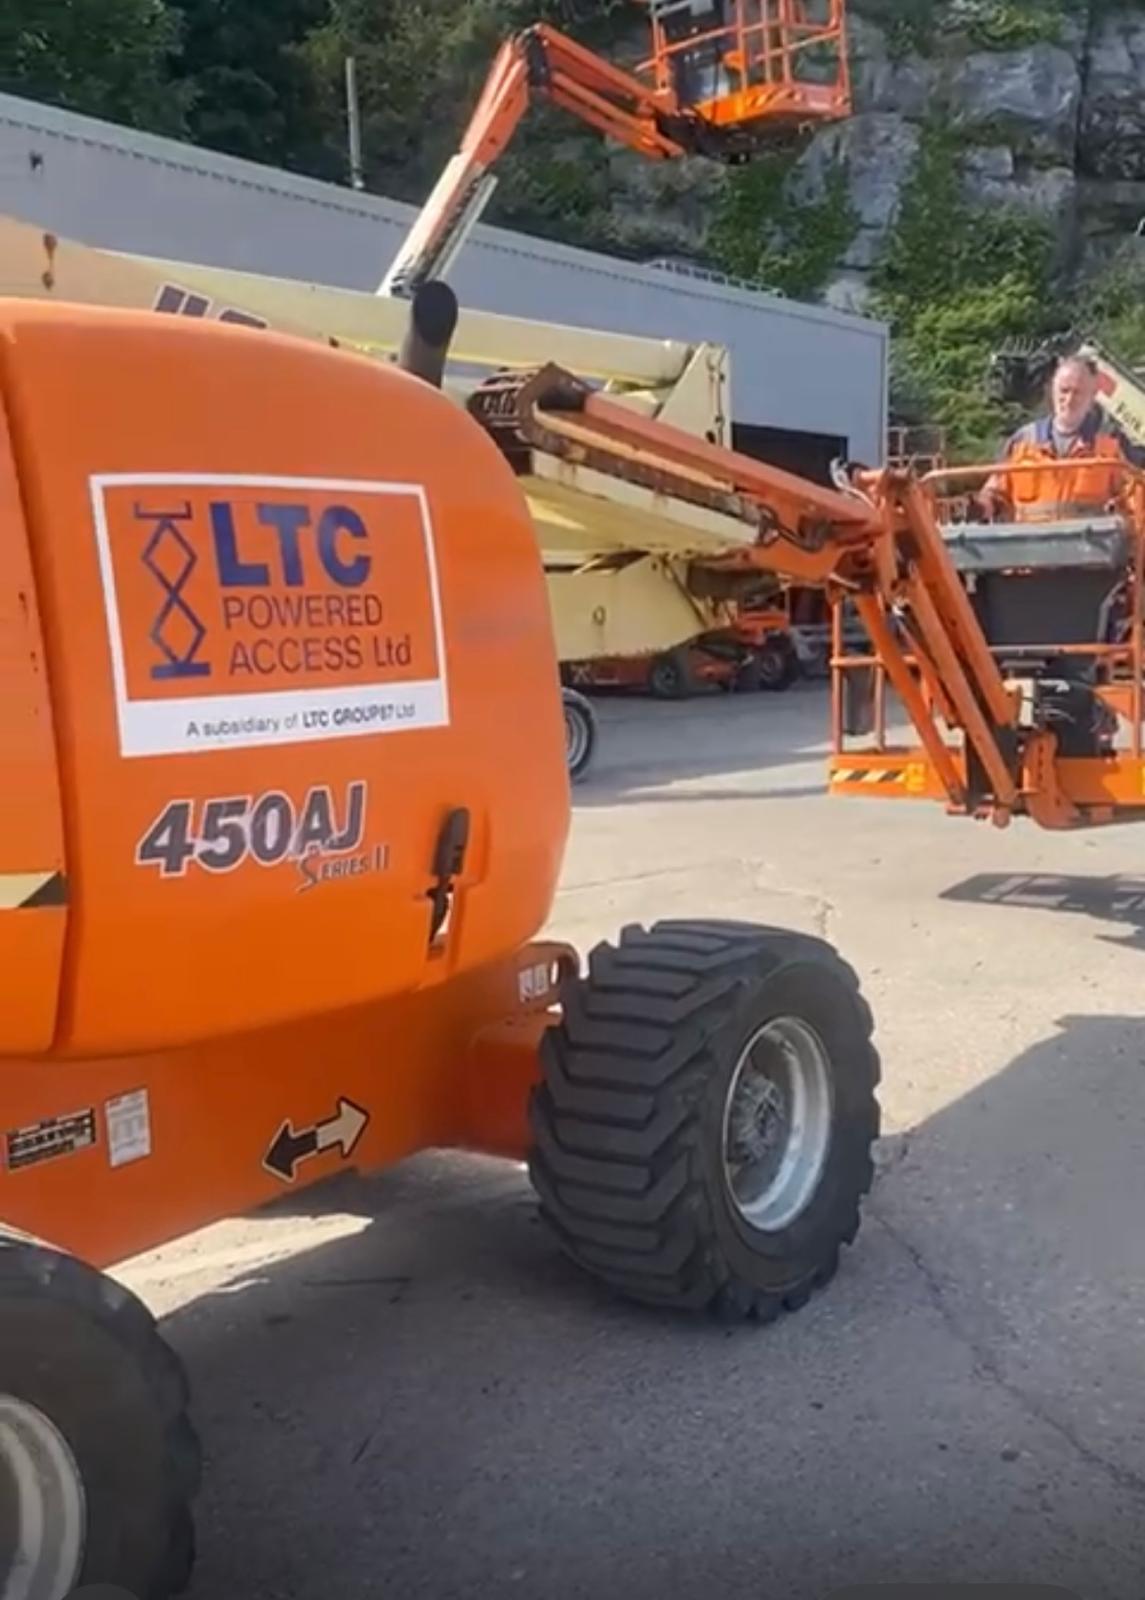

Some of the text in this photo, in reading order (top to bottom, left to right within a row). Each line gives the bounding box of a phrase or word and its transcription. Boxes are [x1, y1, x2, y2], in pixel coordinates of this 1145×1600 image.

[209, 501, 373, 588] LTC
[222, 594, 383, 631] POWERED
[228, 634, 412, 677] ACCESS Ltd
[186, 720, 200, 737] A
[203, 716, 280, 736] subsidiary
[284, 711, 299, 730] of
[302, 709, 329, 729] LTC
[134, 780, 368, 878] 450AJ
